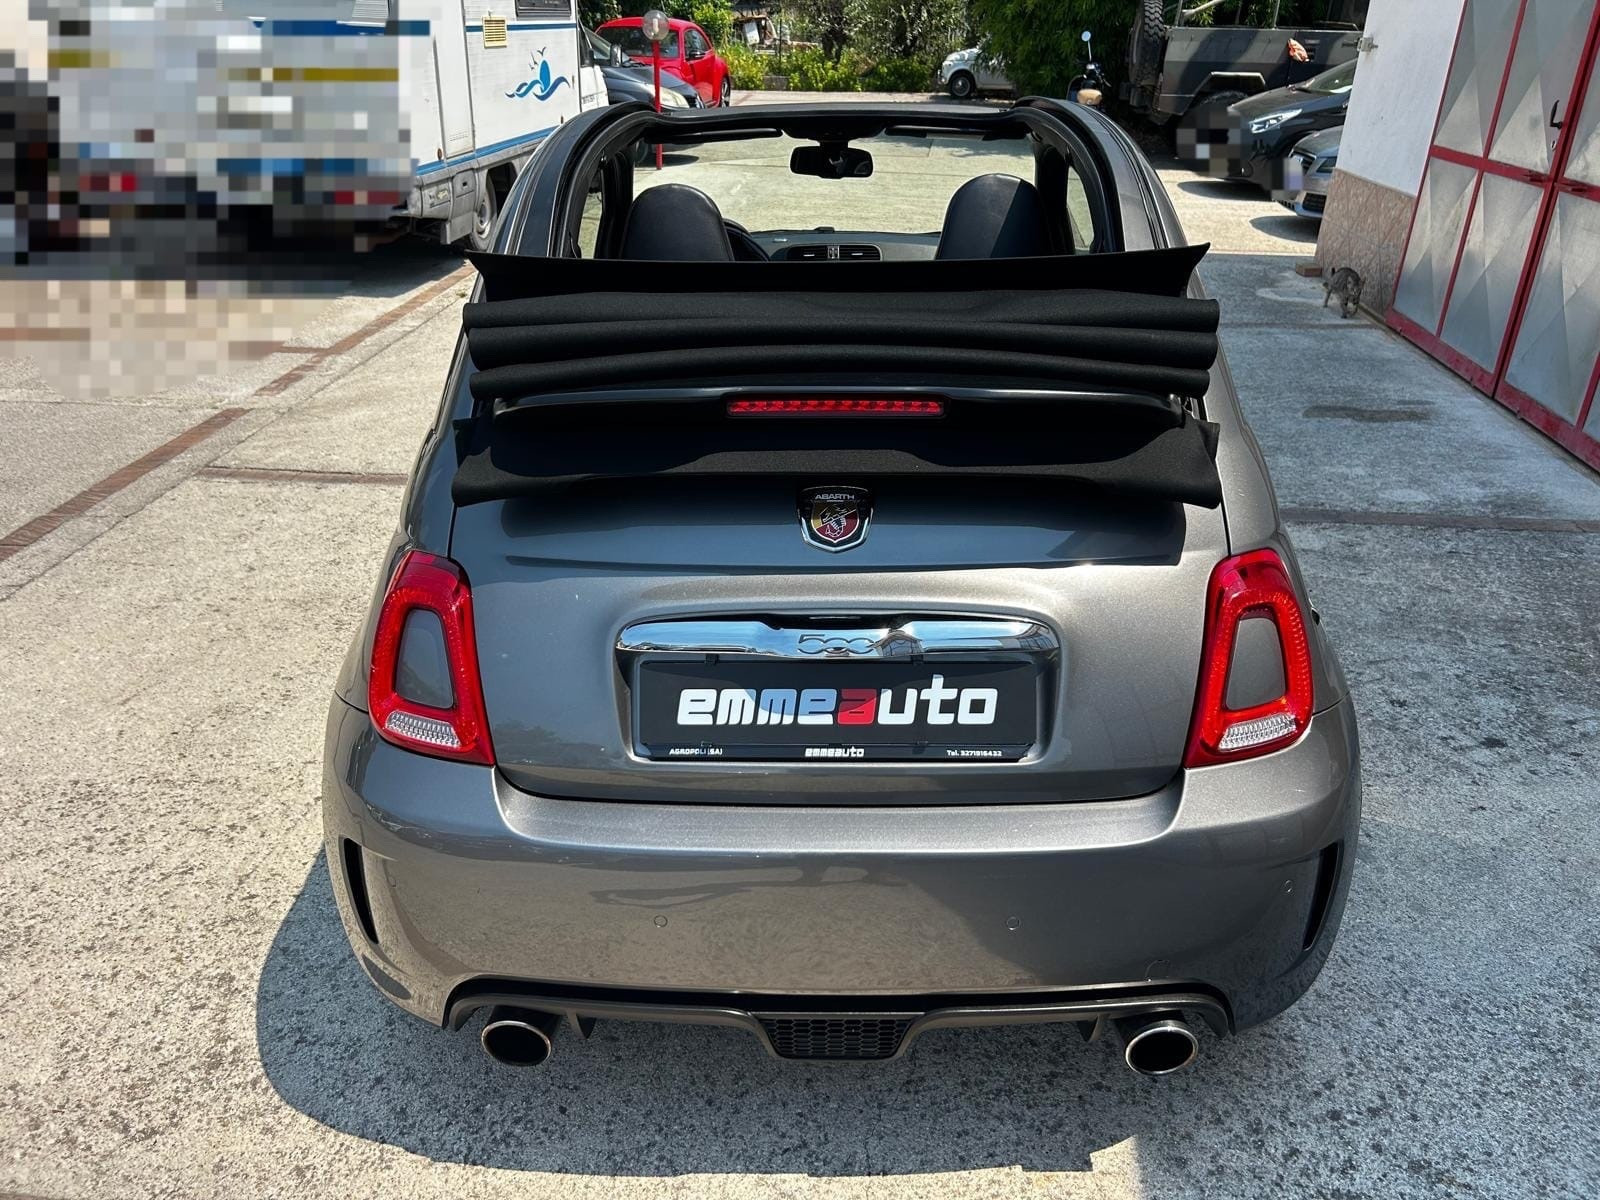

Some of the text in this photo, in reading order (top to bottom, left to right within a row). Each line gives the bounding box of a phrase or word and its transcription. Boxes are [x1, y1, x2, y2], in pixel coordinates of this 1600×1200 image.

[798, 634, 875, 655] 500
[677, 674, 998, 725] emmeauto
[804, 745, 865, 758] emmeauto
[946, 749, 960, 757] Tel.
